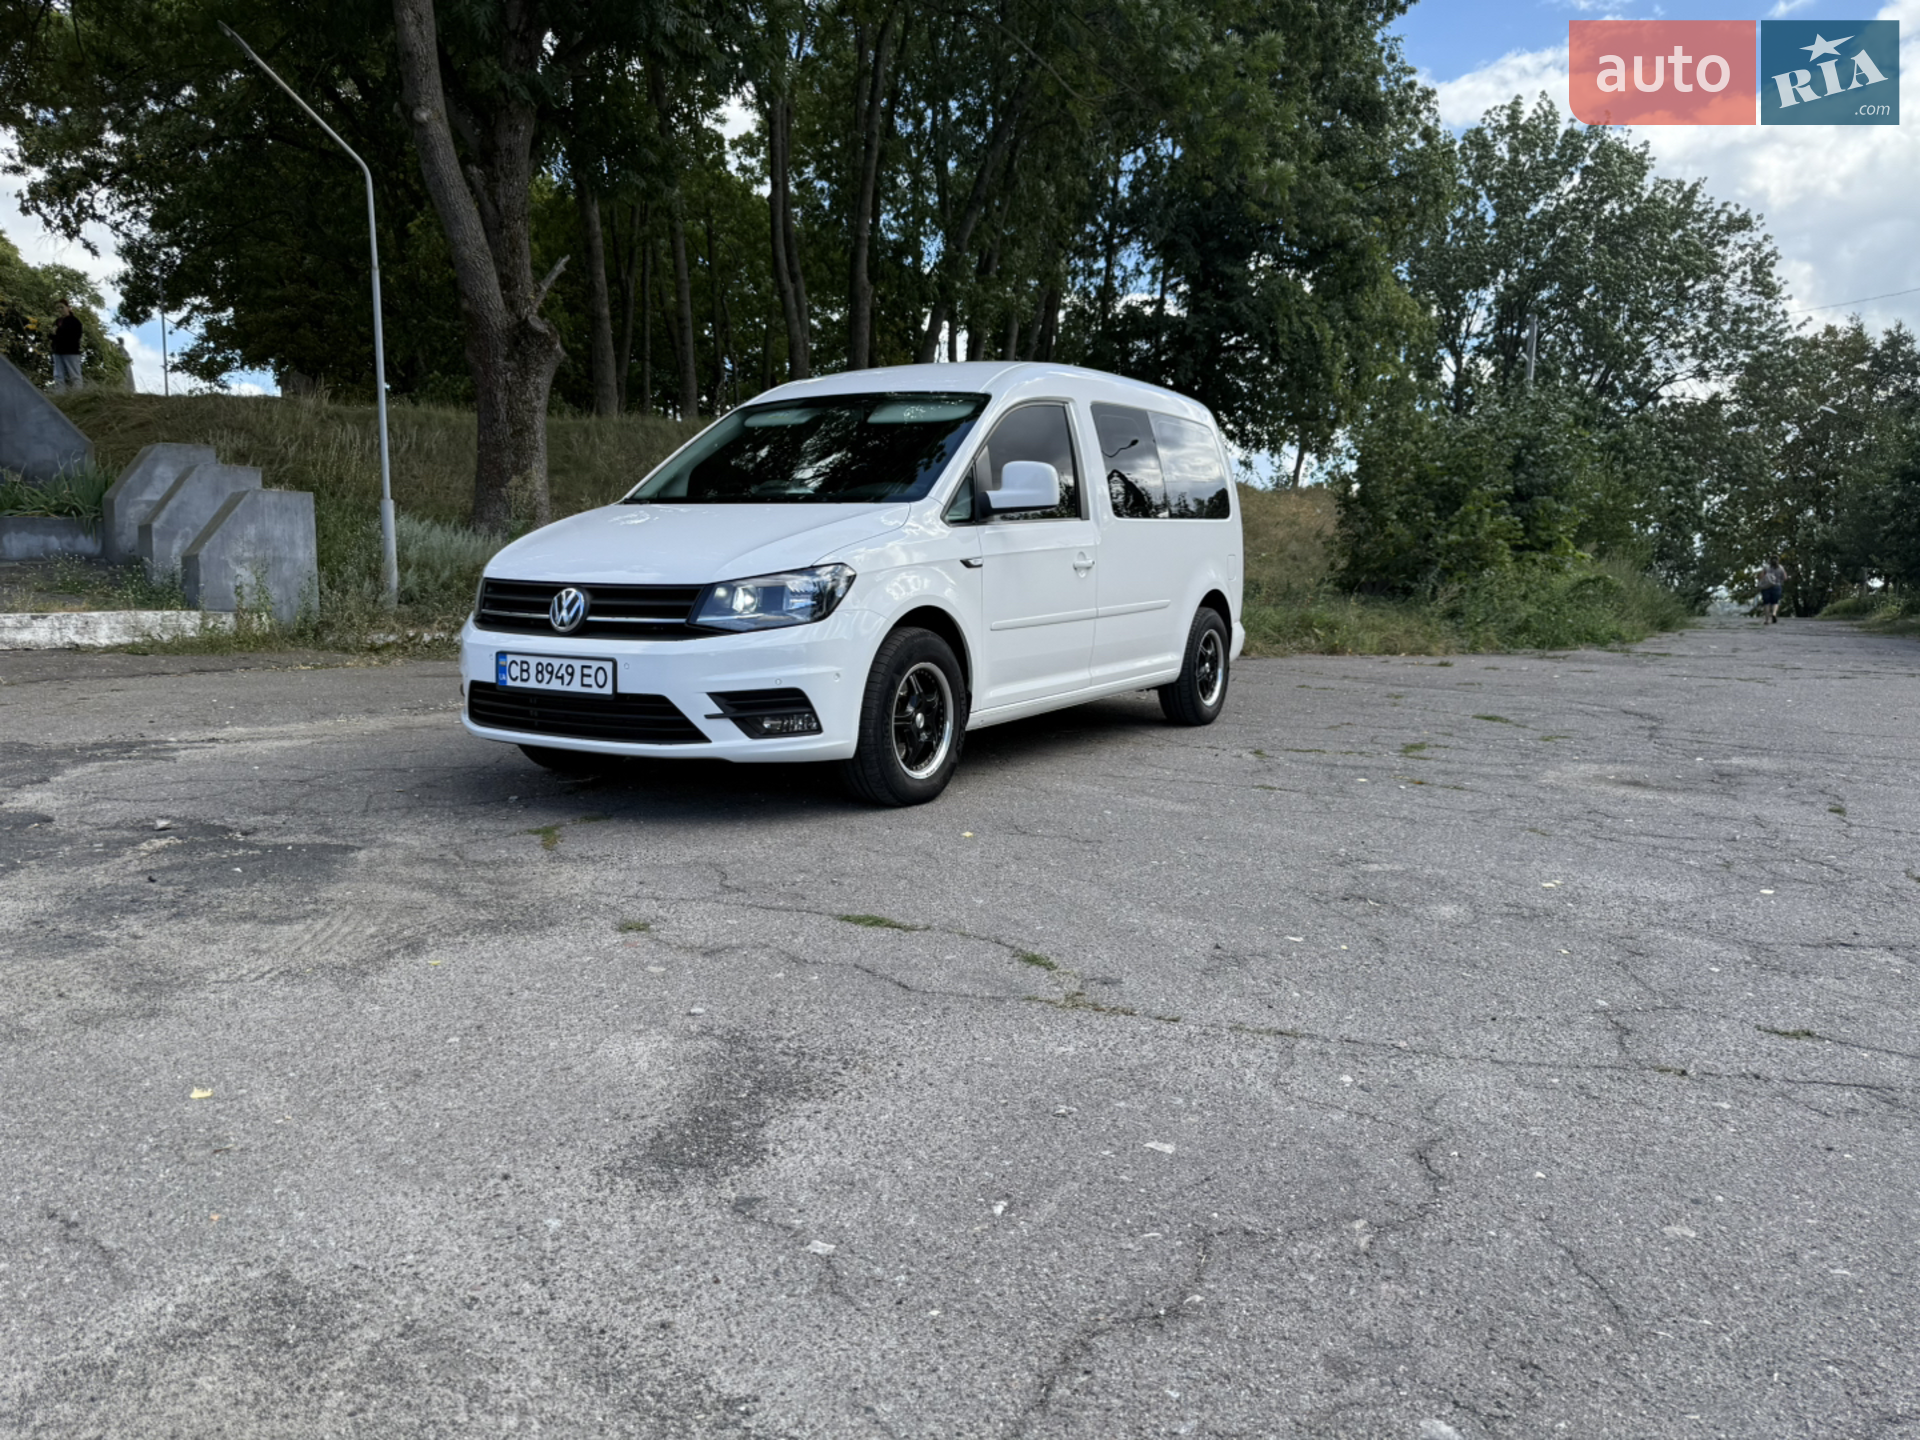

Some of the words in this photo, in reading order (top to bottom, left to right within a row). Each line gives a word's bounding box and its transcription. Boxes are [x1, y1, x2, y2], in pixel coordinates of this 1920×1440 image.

[508, 659, 531, 683] CB
[535, 661, 575, 687] 8949
[580, 665, 608, 689] EO
